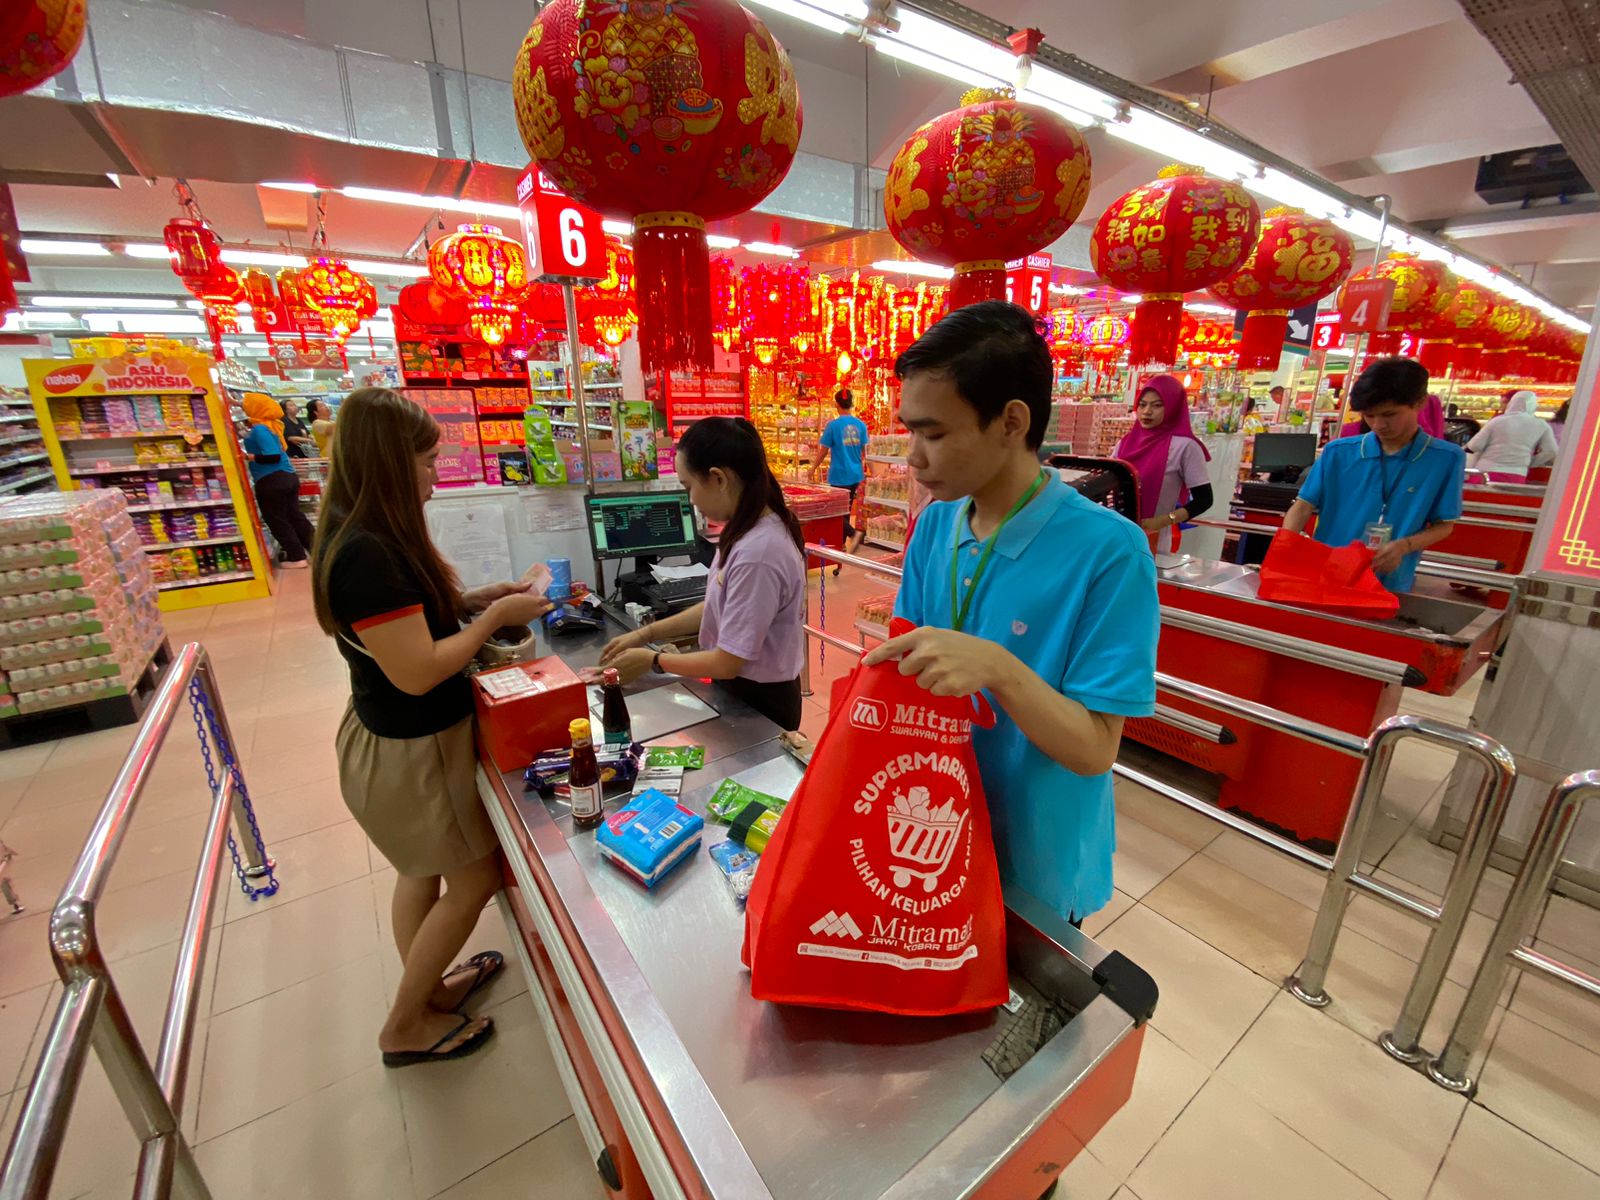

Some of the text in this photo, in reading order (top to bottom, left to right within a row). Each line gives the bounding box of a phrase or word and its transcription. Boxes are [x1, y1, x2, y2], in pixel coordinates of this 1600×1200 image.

[525, 211, 537, 269] 6
[560, 208, 587, 267] 6
[1028, 255, 1050, 269] CASHIER
[1273, 226, 1341, 283] 福
[1031, 276, 1043, 311] 5
[1348, 282, 1384, 293] CASHIER
[1350, 300, 1369, 326] 4
[1318, 326, 1332, 347] 3
[1400, 339, 1411, 356] 2
[128, 365, 166, 377] ASLI
[106, 376, 193, 391] INDONESIA
[893, 703, 958, 733] Mitra
[890, 725, 938, 742] SWALAYAN
[940, 734, 948, 744] &
[850, 838, 967, 916] PILIHAN KELUARGA
[867, 937, 898, 947] JAWI
[903, 942, 940, 952] KOBAR
